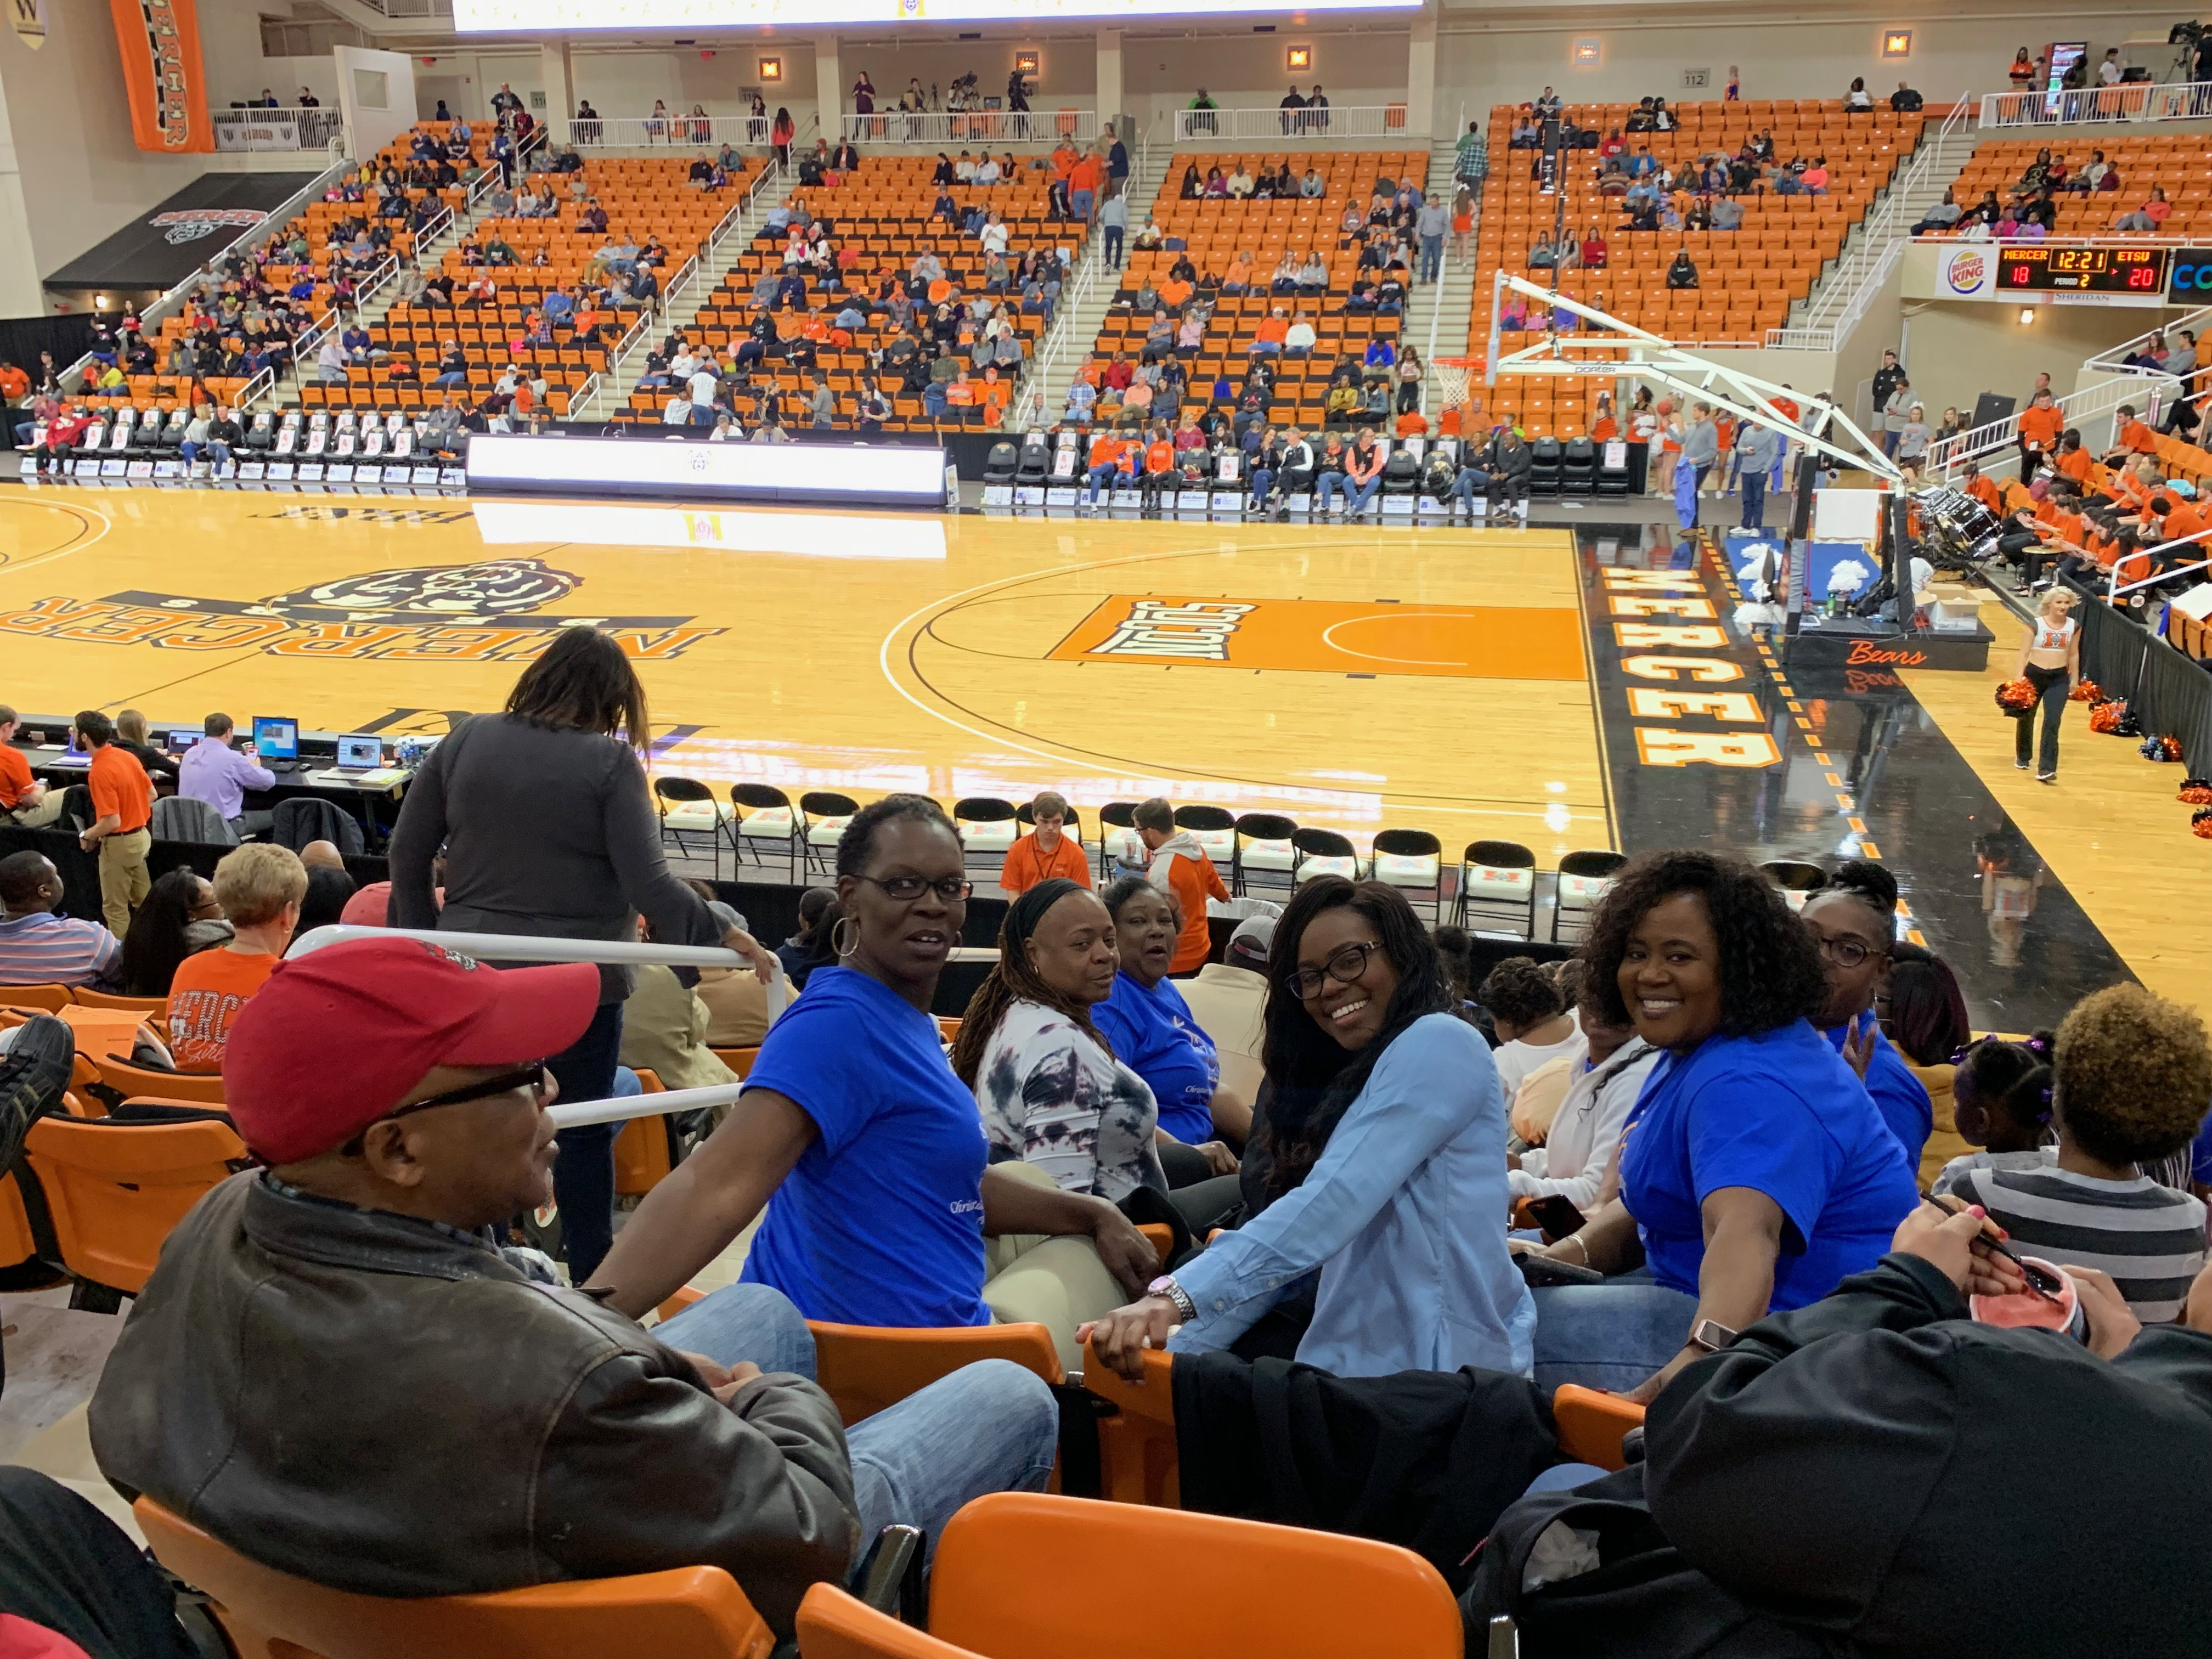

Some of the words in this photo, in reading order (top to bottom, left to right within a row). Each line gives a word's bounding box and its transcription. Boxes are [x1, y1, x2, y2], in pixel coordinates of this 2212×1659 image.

[146, 0, 189, 144] ERCER
[1685, 76, 1704, 86] 112
[2004, 250, 2049, 260] MERCER
[2058, 251, 2104, 269] 12:21
[2117, 251, 2150, 261] ETSU
[1951, 257, 1984, 274] BURGER
[1951, 266, 1984, 285] KING
[2013, 267, 2030, 283] 18
[2054, 277, 2078, 286] PERIOD
[2080, 274, 2090, 287] 2
[2129, 268, 2154, 286] 20
[2055, 293, 2110, 301] SHERIDAN
[1846, 640, 1928, 665] Bears
[1601, 567, 1783, 768] MERCER
